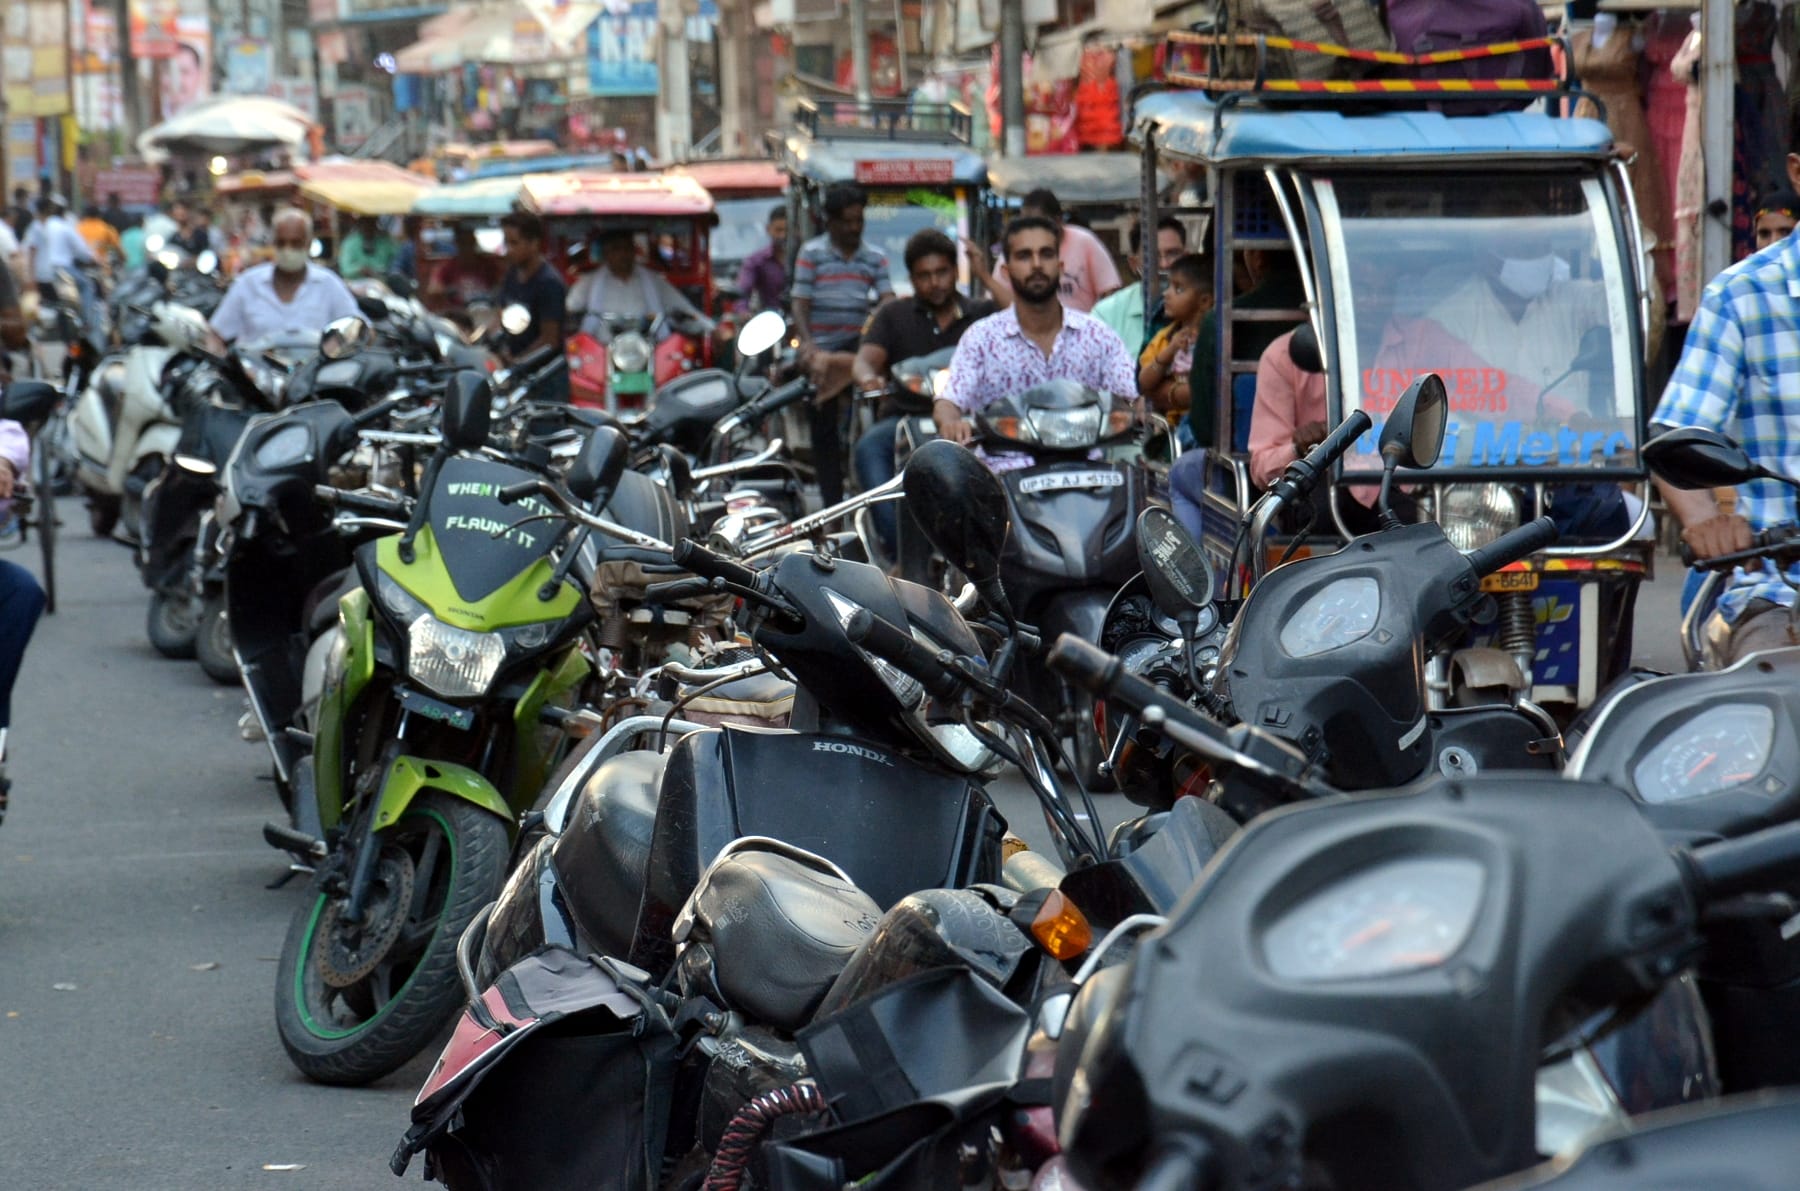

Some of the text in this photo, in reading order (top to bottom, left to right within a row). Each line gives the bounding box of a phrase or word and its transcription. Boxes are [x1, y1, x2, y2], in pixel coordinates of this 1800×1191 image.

[1363, 367, 1508, 394] UNTED
[447, 483, 492, 496] WHEN
[445, 515, 536, 548] FLAUNT IT
